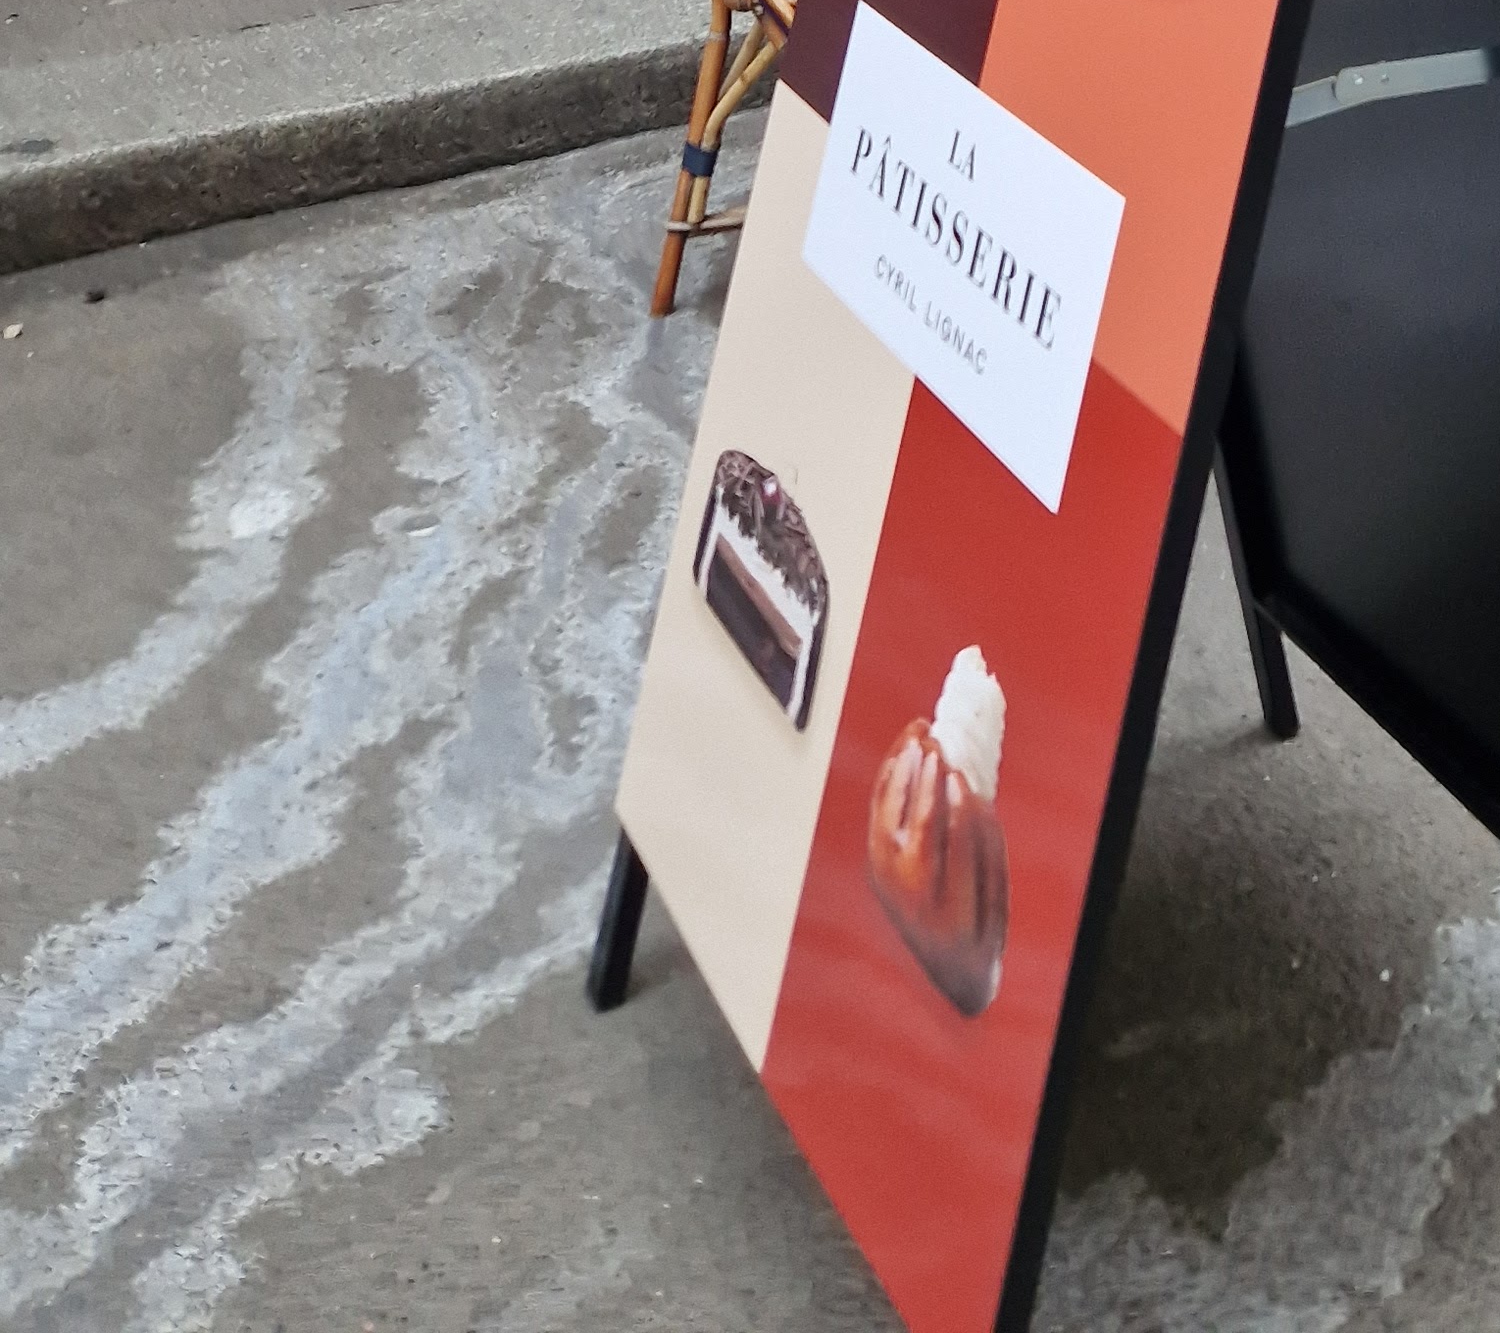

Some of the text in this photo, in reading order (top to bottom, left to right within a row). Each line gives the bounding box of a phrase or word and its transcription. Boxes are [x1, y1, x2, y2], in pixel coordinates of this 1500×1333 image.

[947, 129, 976, 182] LA
[850, 125, 1062, 352] PÂTISSERIE
[874, 253, 989, 376] CYRIL LIGNAC
